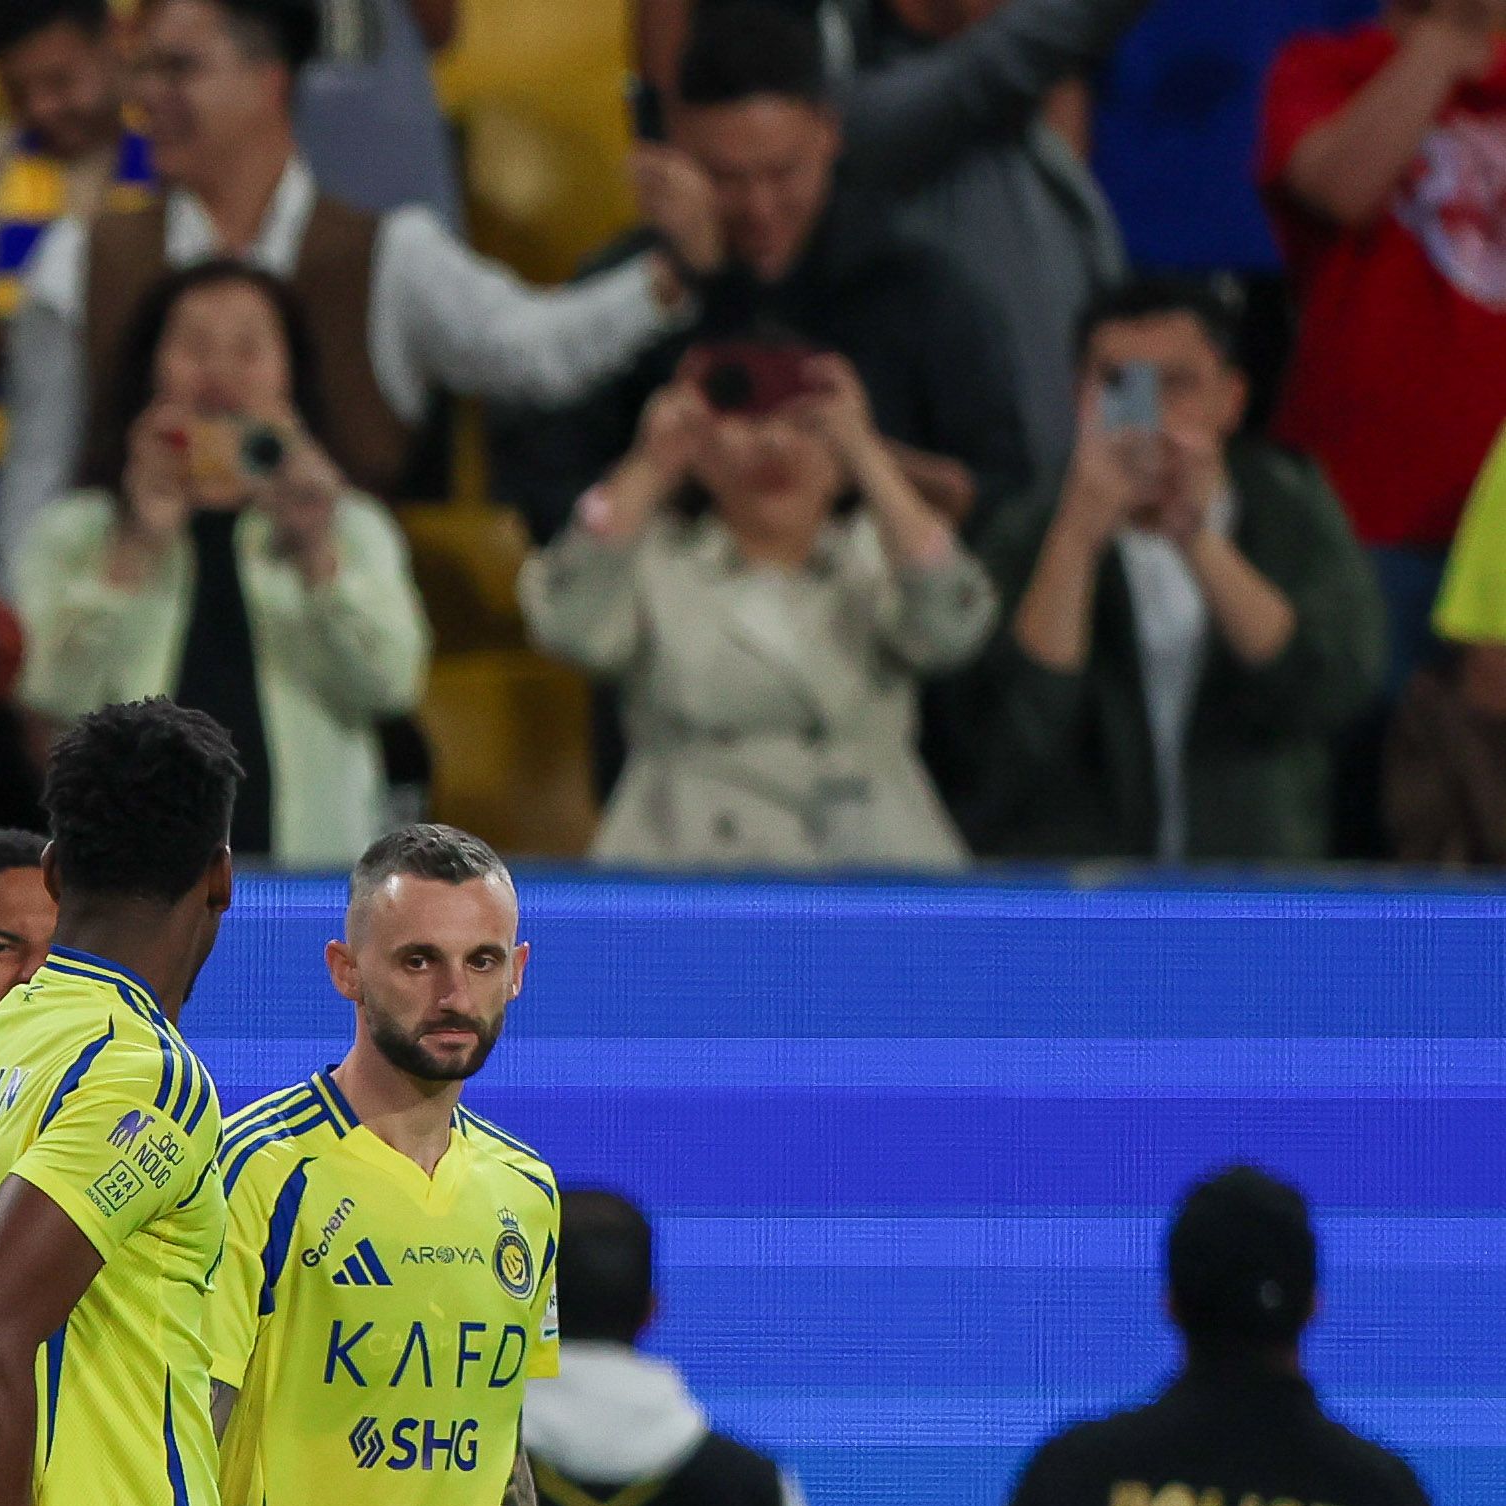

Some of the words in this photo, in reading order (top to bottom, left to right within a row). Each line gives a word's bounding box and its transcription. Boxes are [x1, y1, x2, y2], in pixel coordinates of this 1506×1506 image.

[401, 1246, 485, 1265] AROYA
[323, 1319, 528, 1389] KAFD
[385, 1417, 479, 1472] SHG
